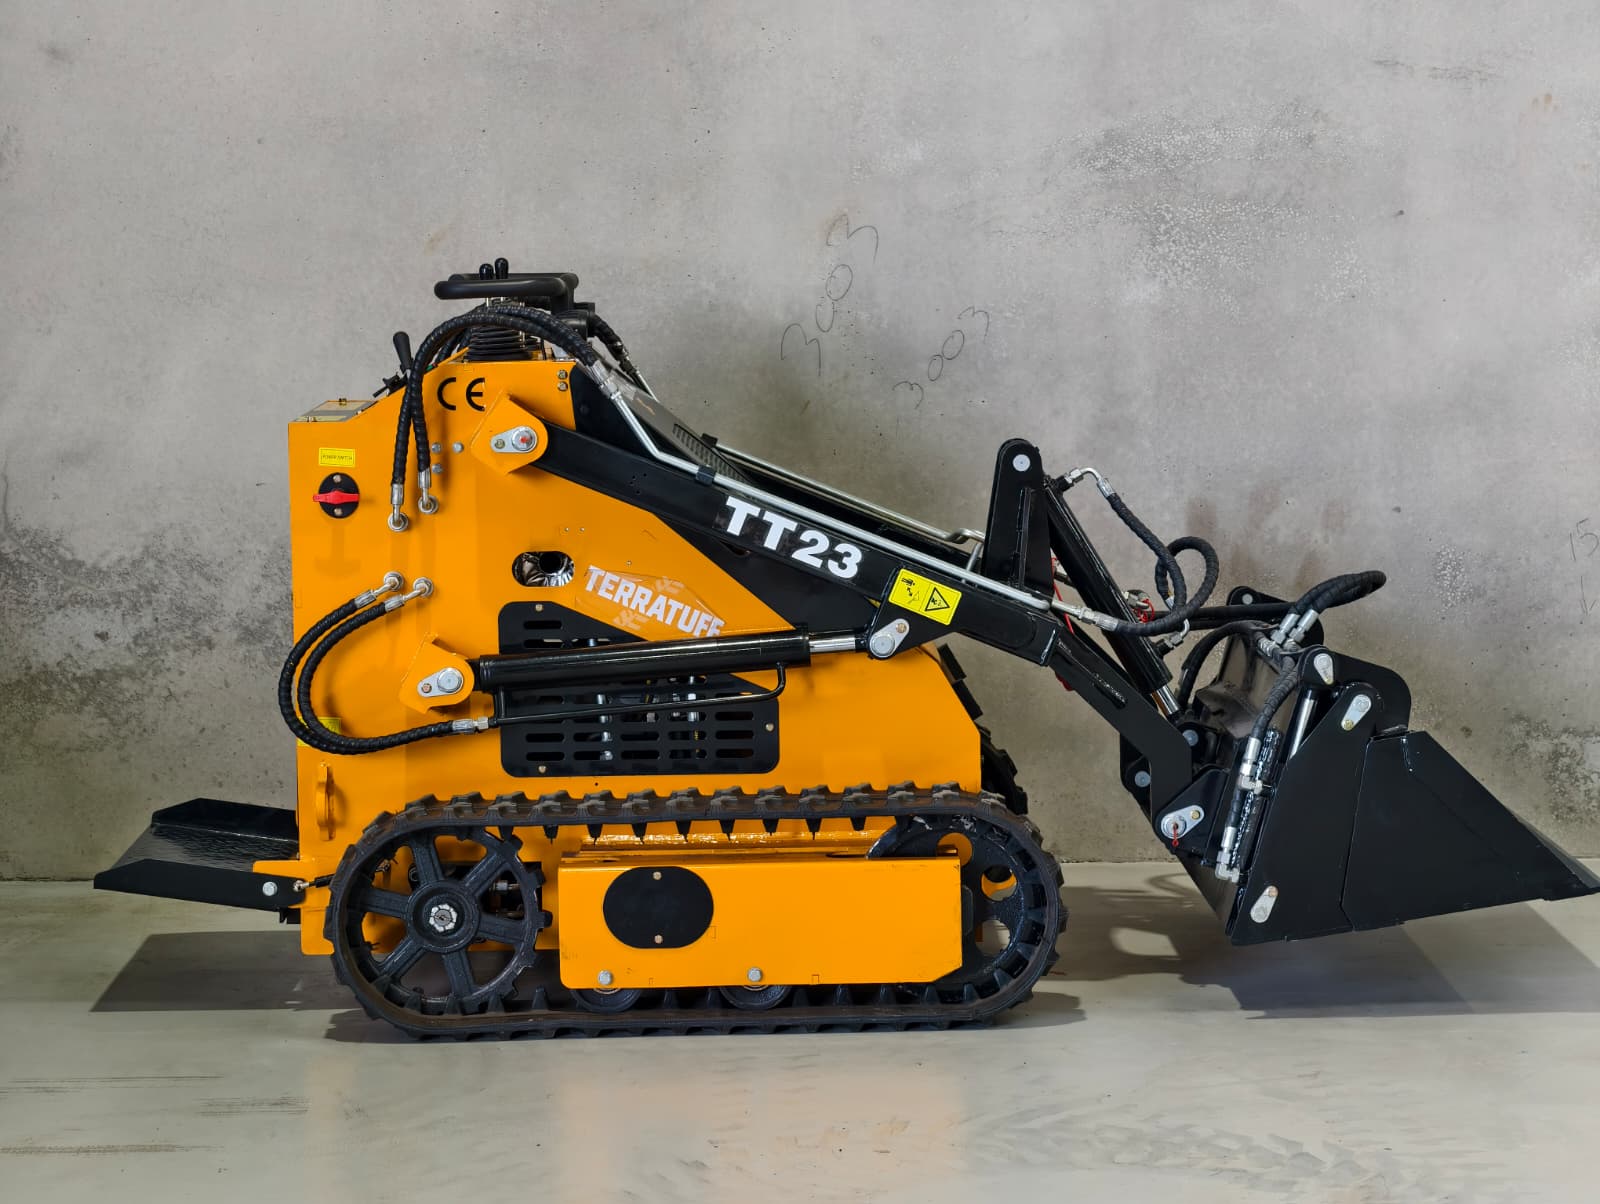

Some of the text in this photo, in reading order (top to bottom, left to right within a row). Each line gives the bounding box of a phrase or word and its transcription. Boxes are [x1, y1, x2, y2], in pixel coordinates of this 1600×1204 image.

[437, 376, 485, 412] CE
[726, 495, 862, 579] TT23
[585, 565, 726, 637] TERRATUFF
